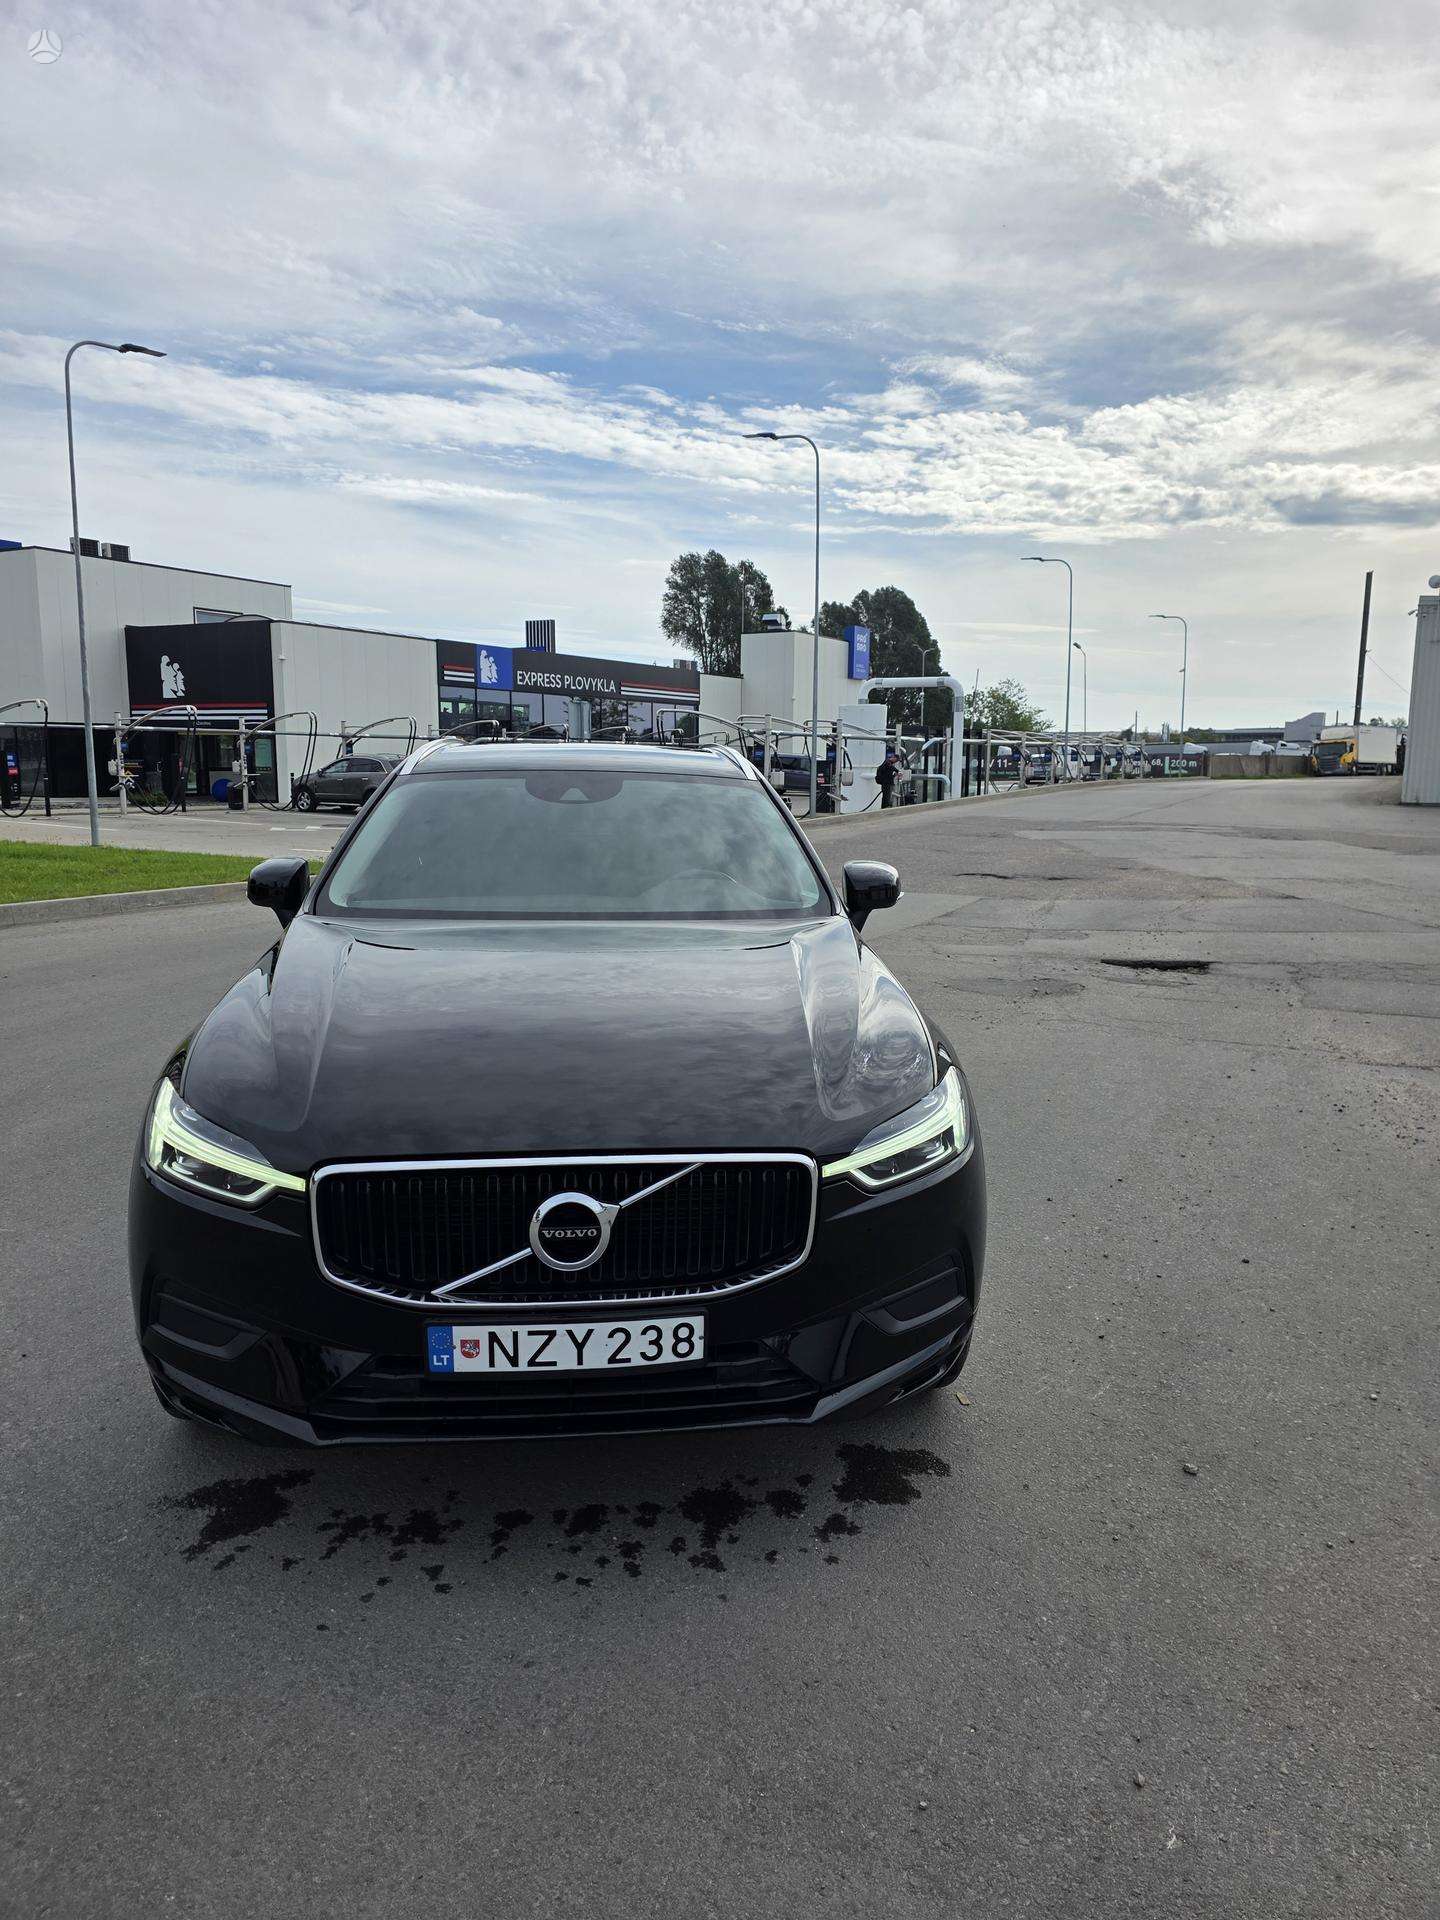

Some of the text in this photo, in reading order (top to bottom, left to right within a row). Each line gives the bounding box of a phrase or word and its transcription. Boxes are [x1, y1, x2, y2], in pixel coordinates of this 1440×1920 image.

[516, 671, 617, 693] EXPRESS PLOVYKLA
[541, 1228, 597, 1238] VOLVO
[488, 1322, 695, 1368] NZY 238
[433, 1354, 450, 1366] LT
